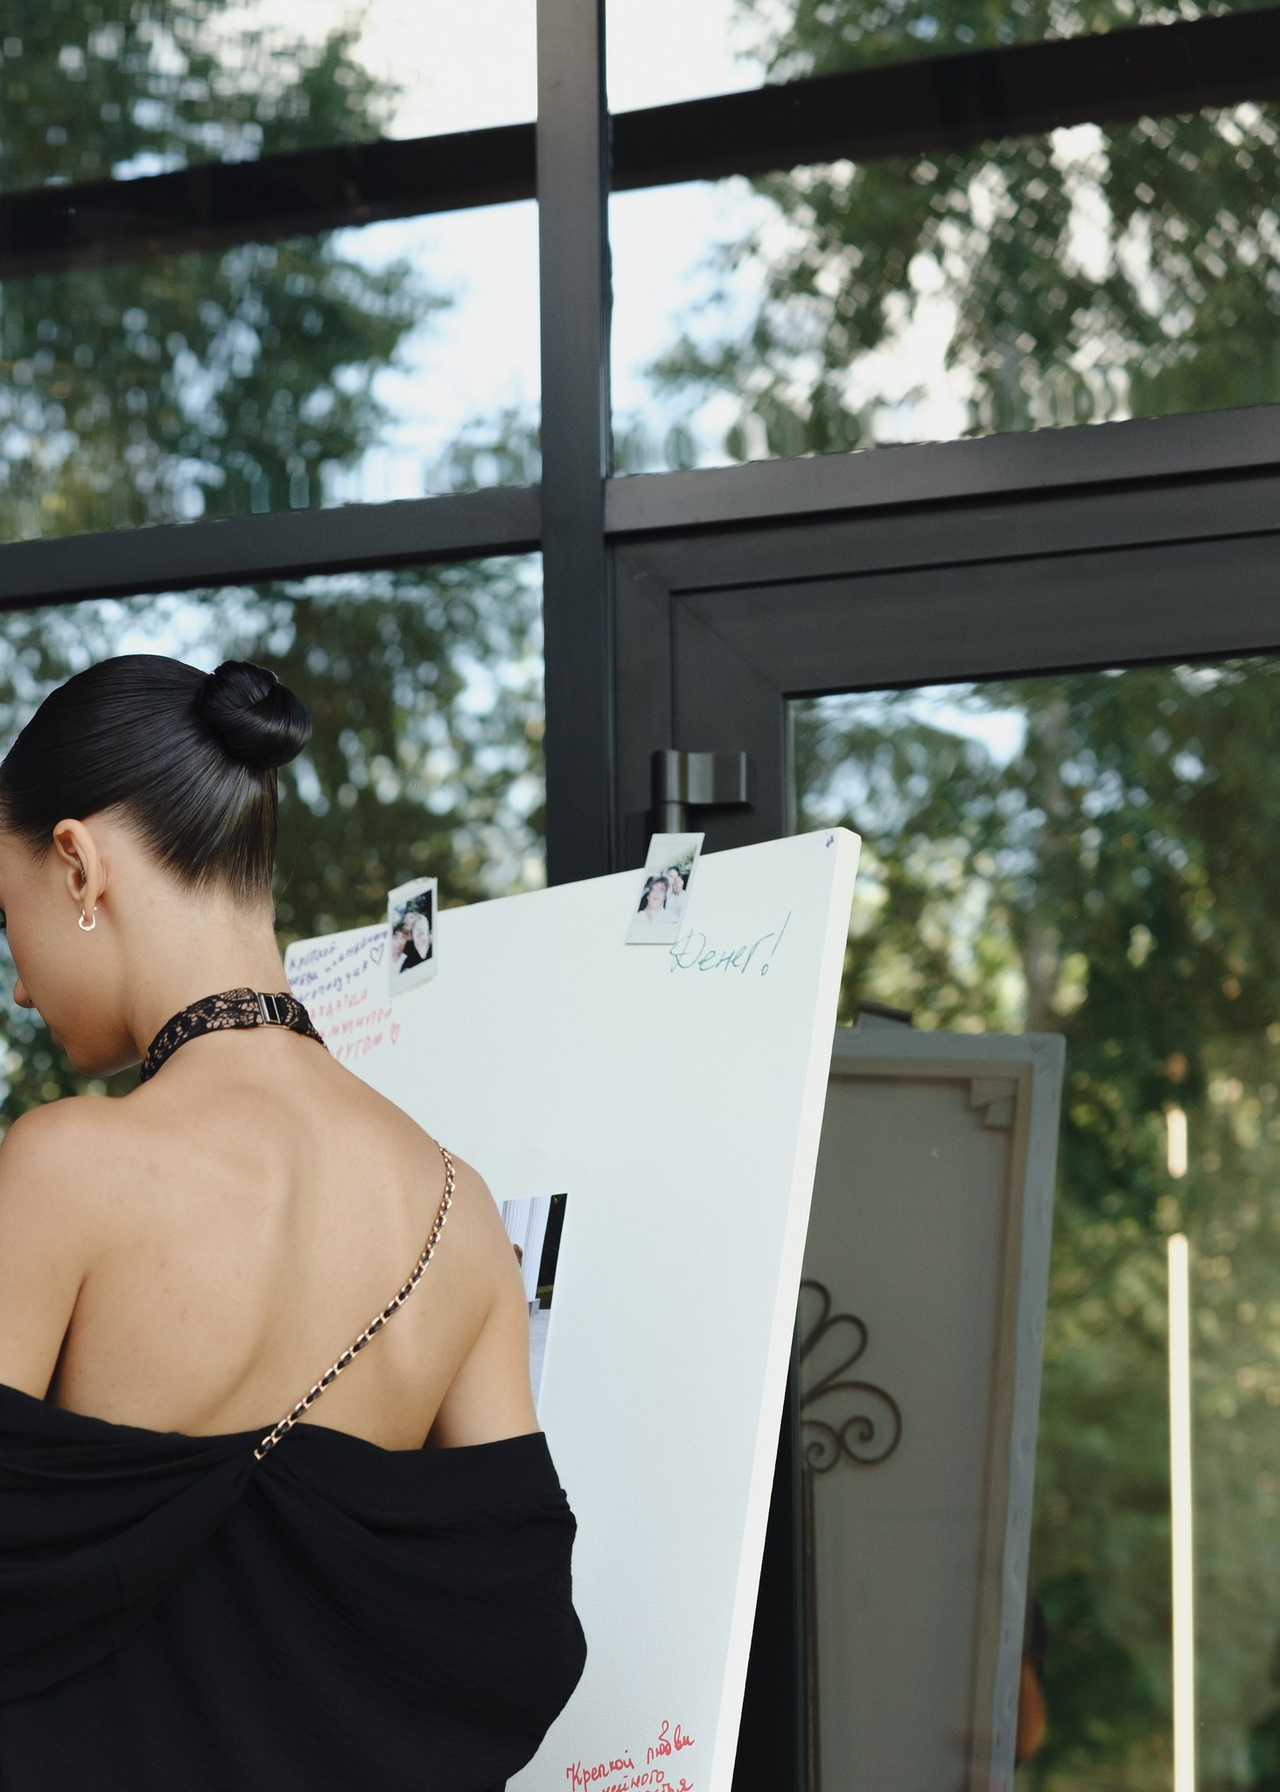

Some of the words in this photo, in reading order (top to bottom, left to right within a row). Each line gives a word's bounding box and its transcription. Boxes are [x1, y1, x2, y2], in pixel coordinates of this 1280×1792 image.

[669, 910, 792, 976] Денег!
[566, 1749, 635, 1792] Крепкой
[645, 1719, 695, 1765] любви
